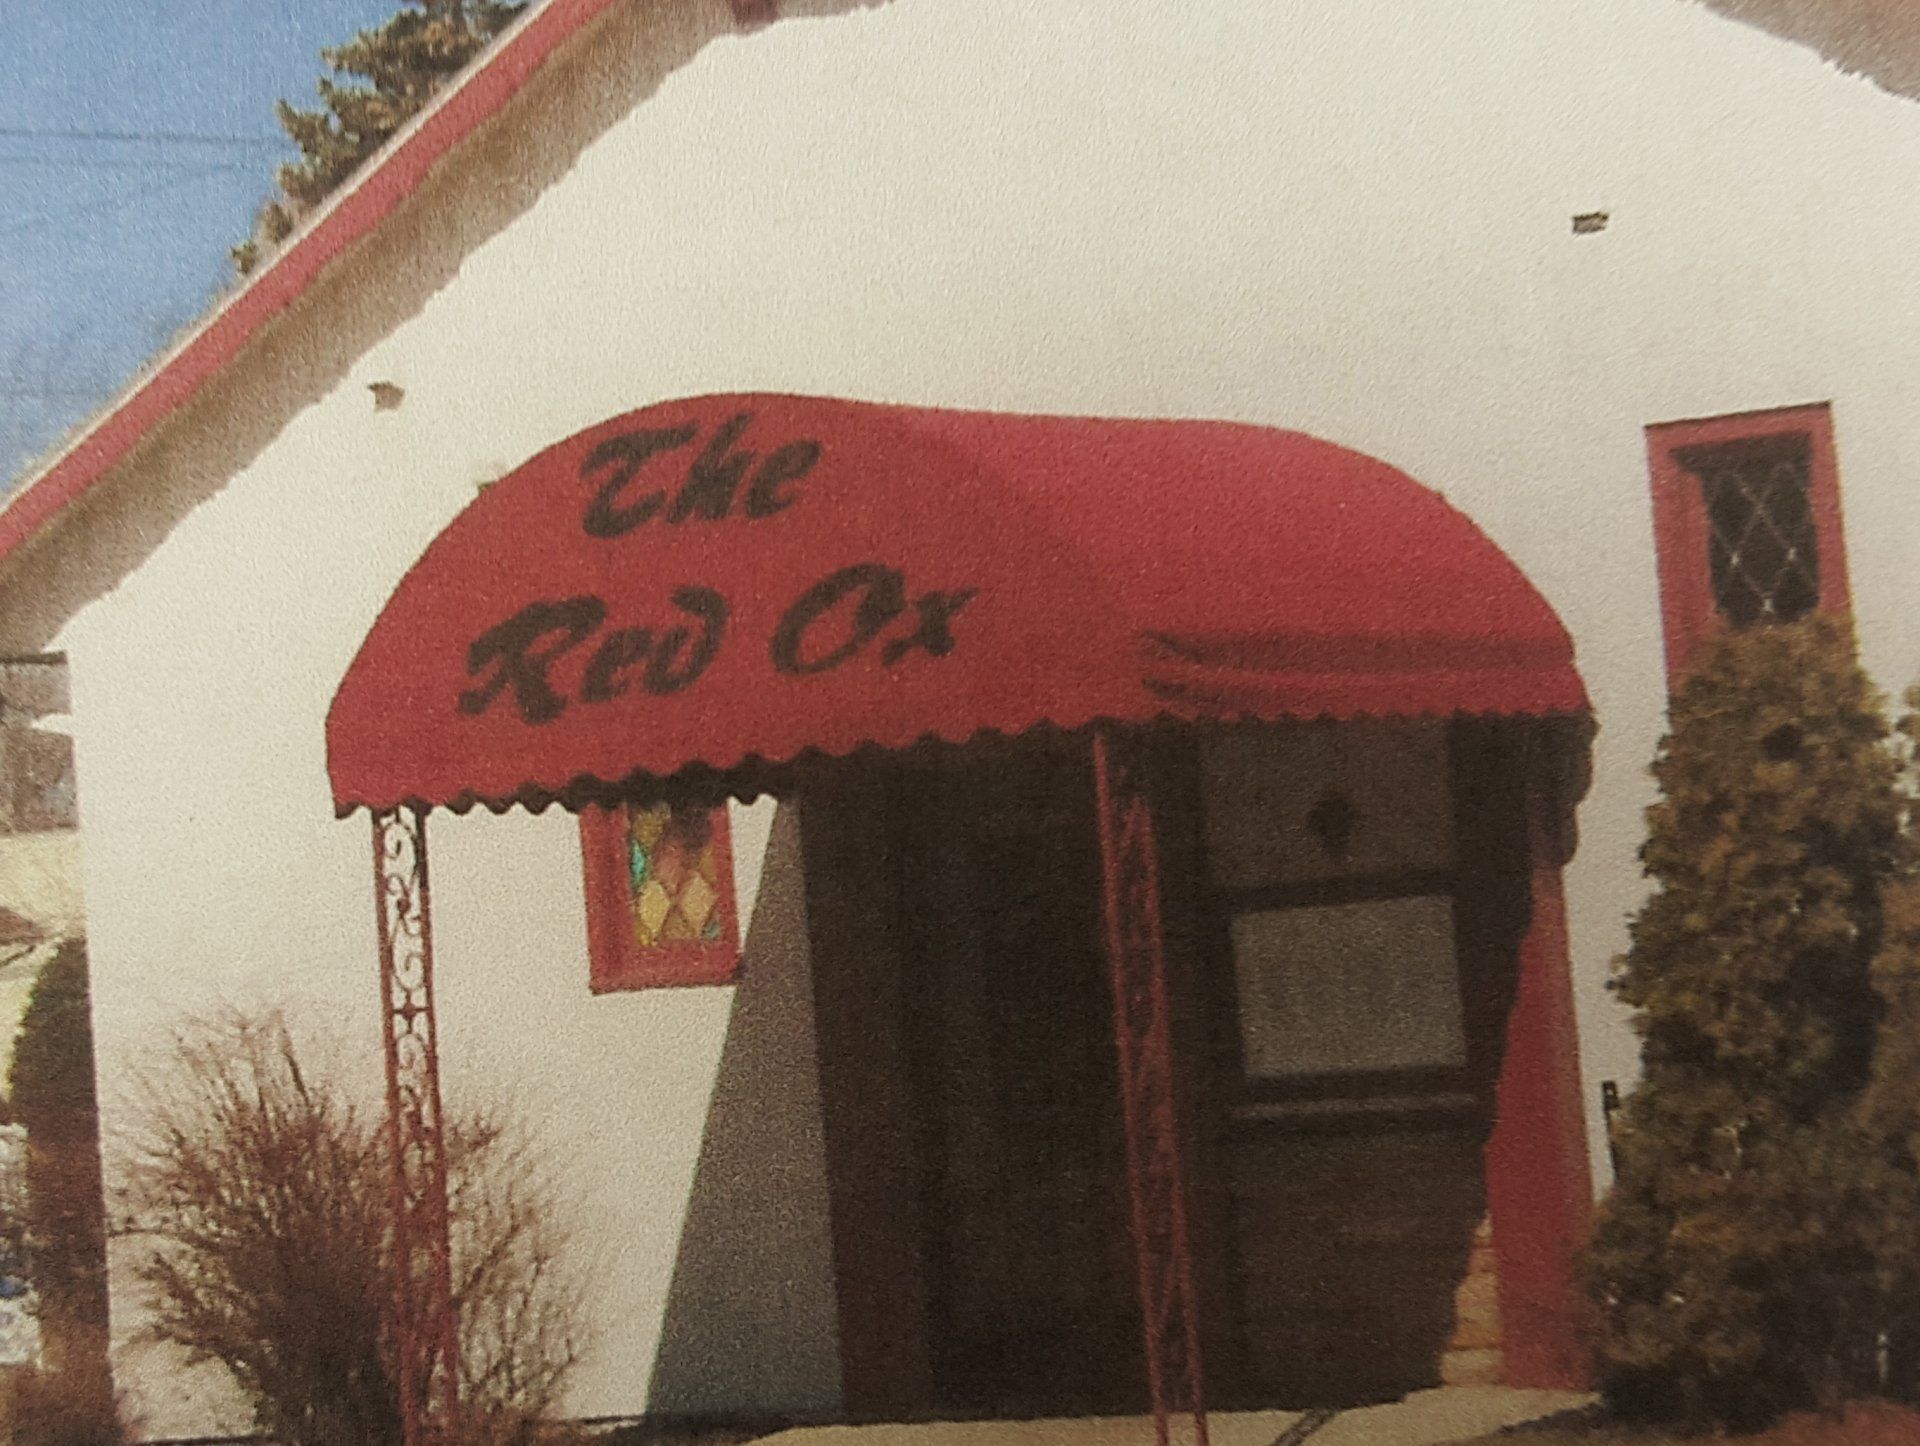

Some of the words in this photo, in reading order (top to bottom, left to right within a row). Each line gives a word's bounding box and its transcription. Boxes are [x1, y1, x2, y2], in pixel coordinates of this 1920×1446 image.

[579, 409, 822, 539] The
[457, 586, 730, 726] Red
[770, 562, 980, 677] Ox
